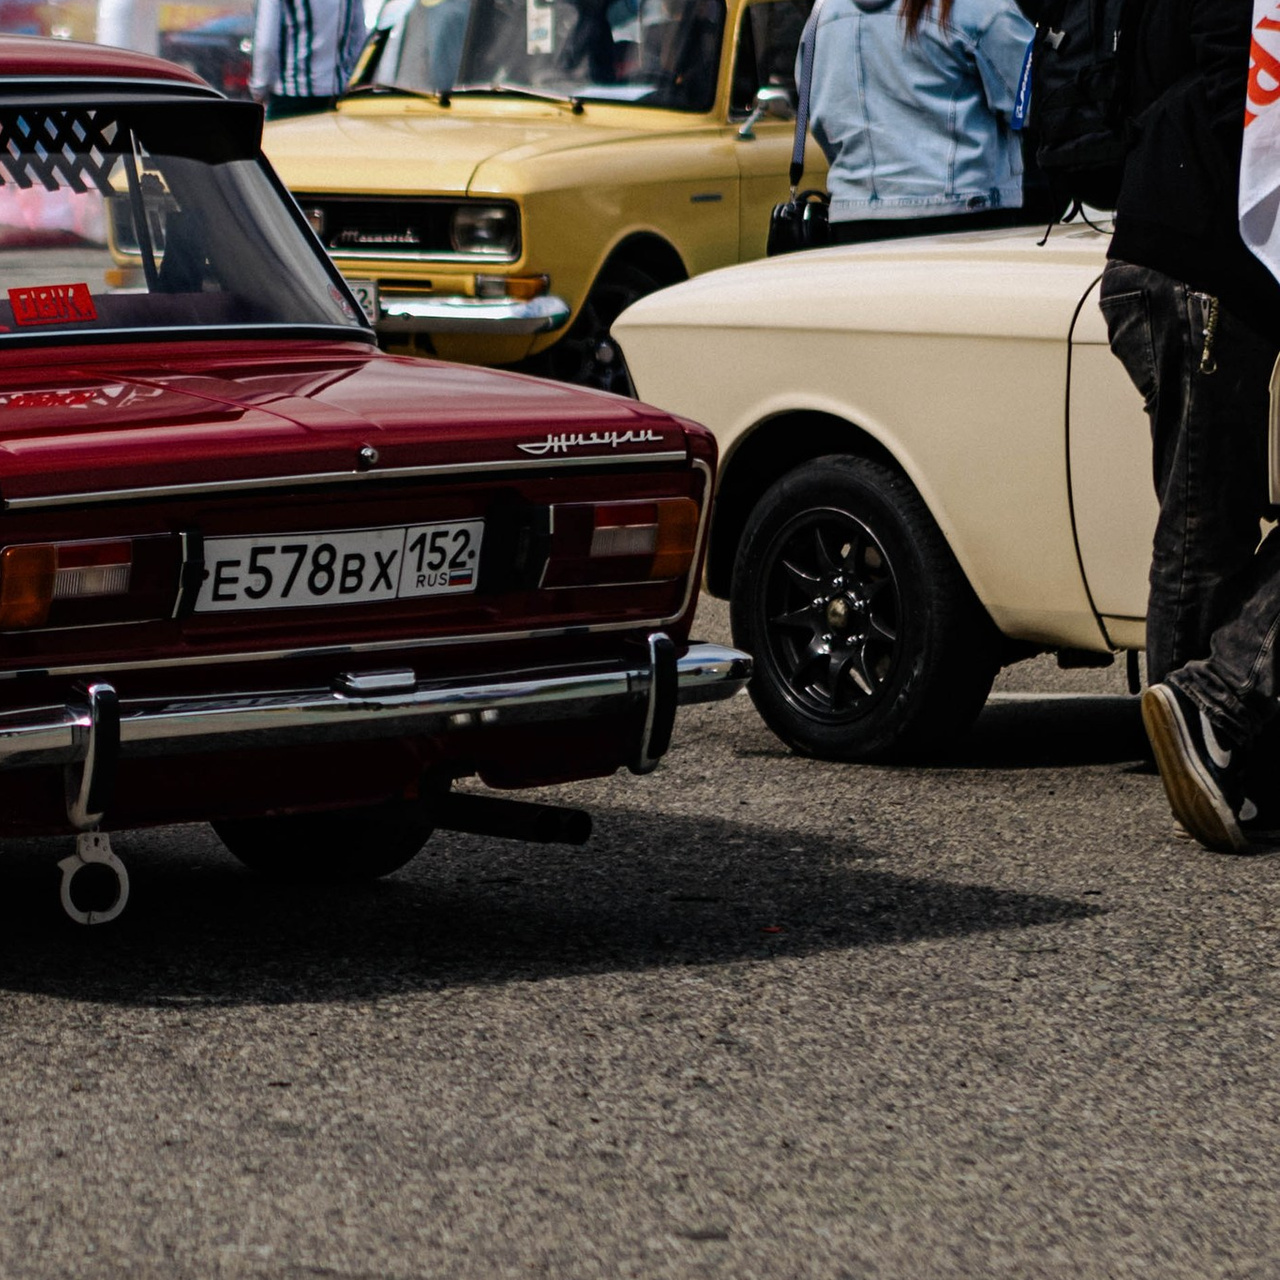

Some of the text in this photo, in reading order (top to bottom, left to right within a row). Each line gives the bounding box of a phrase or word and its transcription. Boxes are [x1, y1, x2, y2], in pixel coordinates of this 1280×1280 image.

[517, 429, 664, 455] Жигули
[408, 528, 471, 573] 152
[415, 572, 448, 588] RUS
